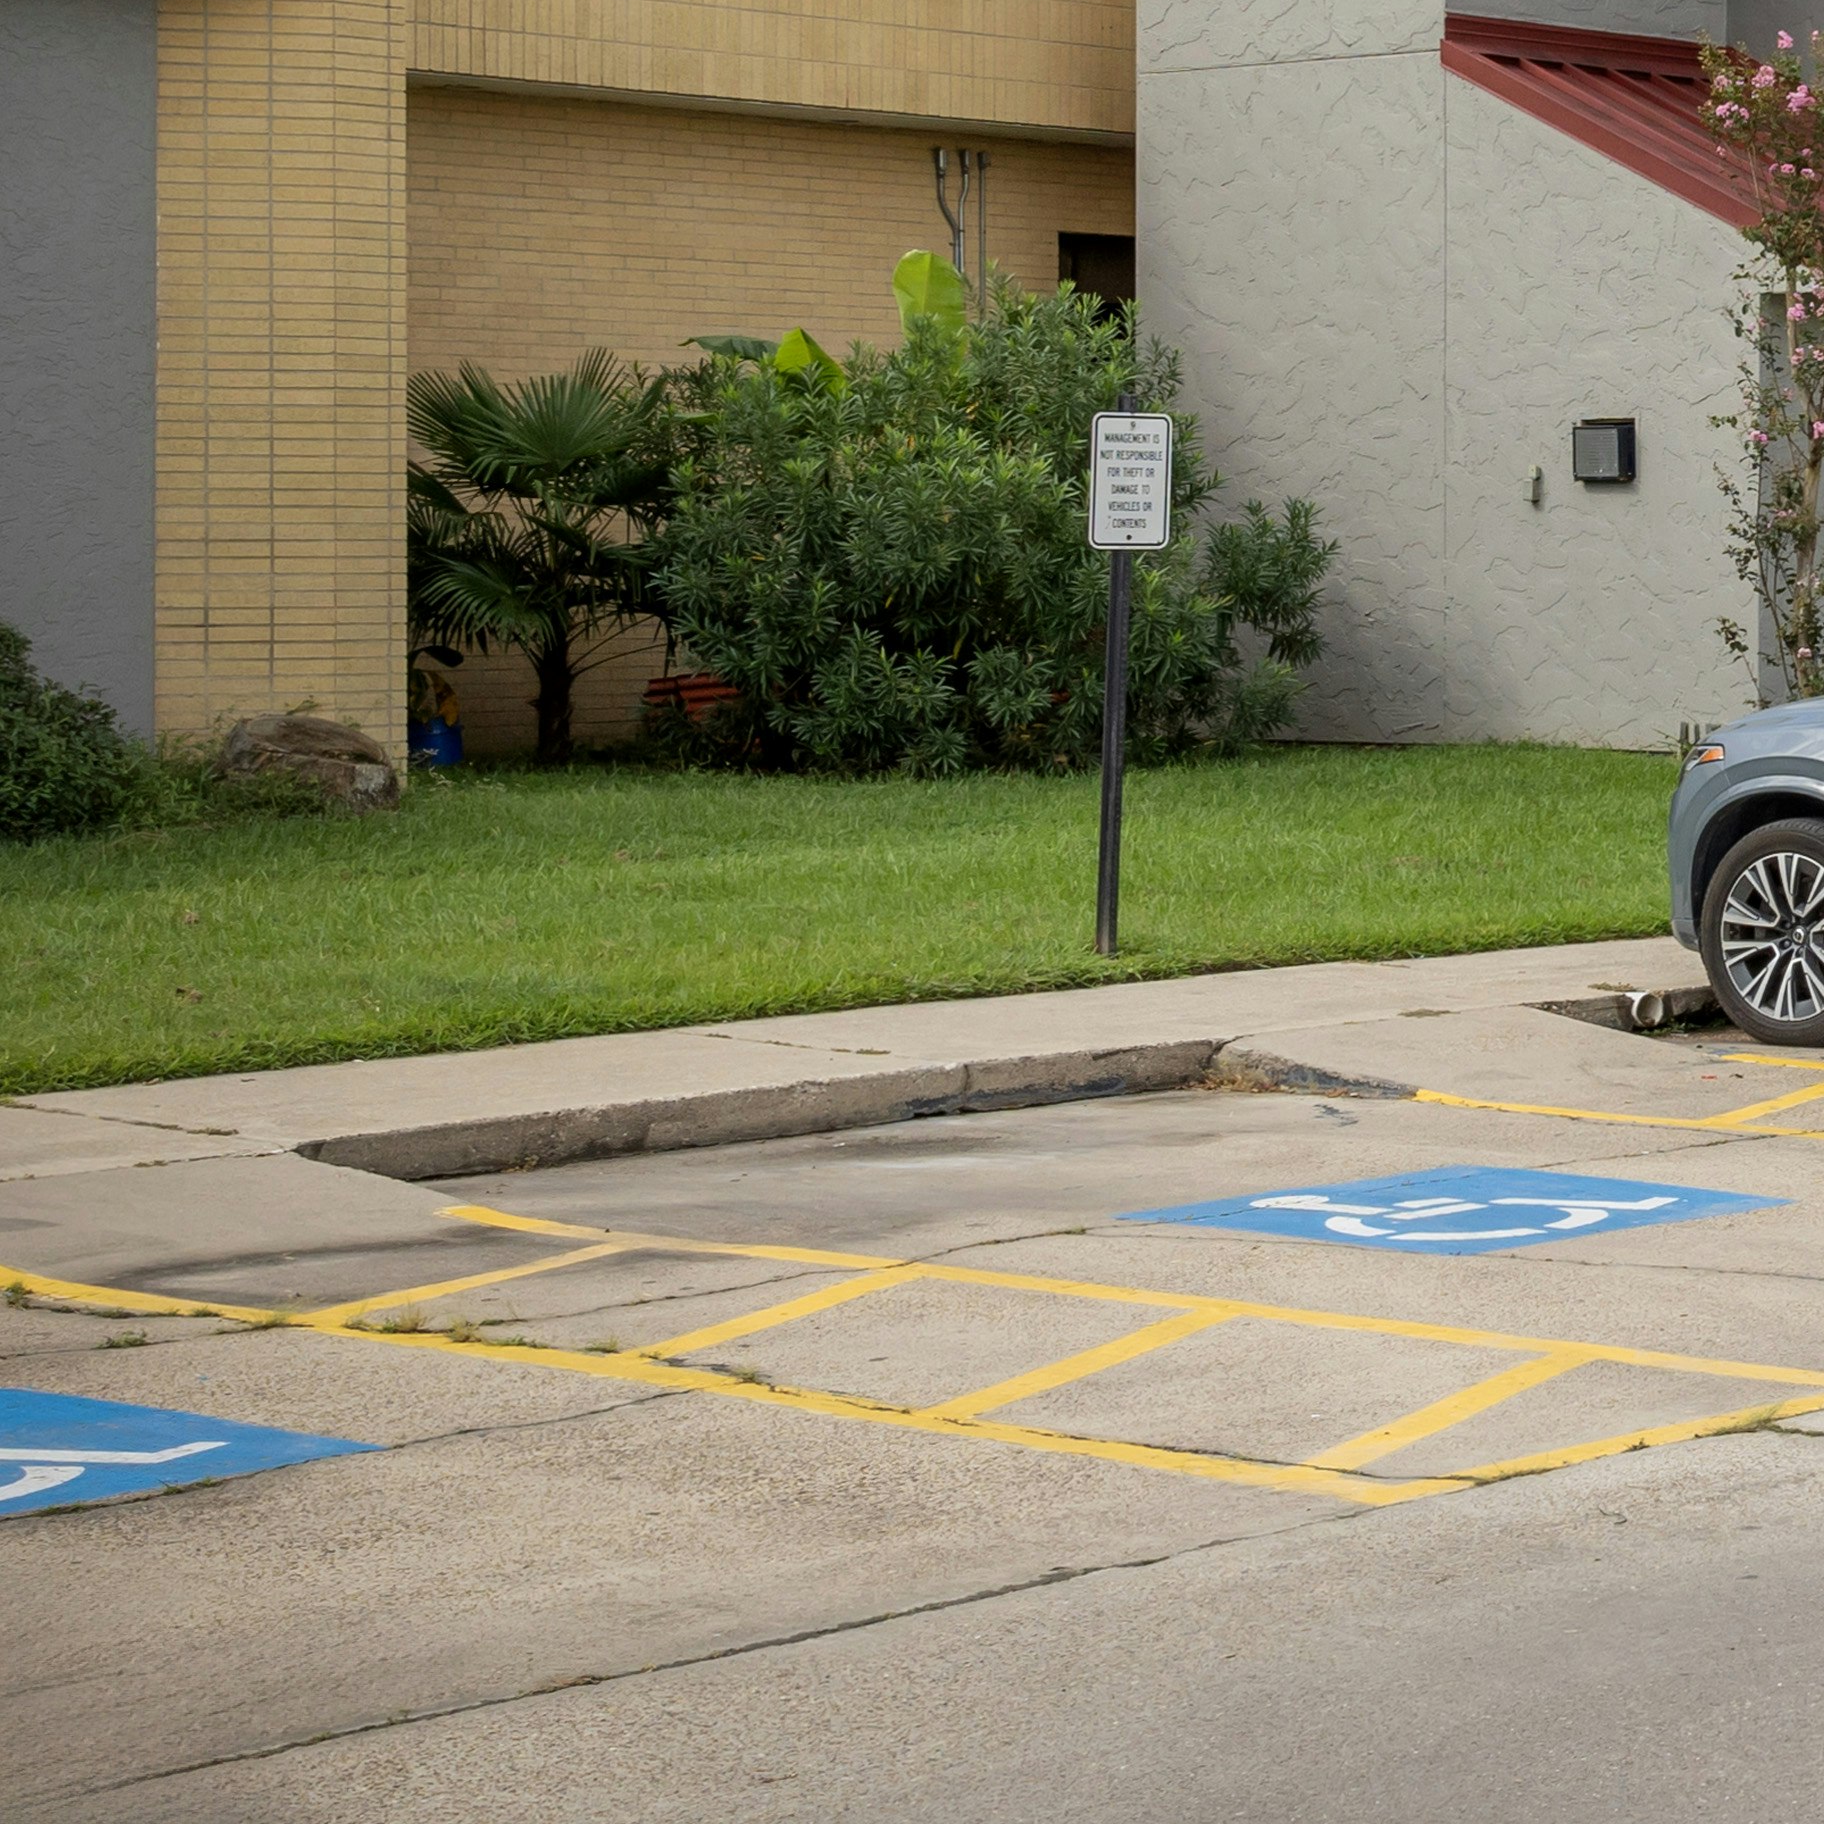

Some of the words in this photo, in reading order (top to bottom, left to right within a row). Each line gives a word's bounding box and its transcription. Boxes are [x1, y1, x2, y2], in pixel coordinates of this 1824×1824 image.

[1104, 432, 1151, 443] MANAGEMENT
[1152, 433, 1160, 444] IS
[1100, 449, 1114, 460] NOT
[1116, 450, 1163, 461] RESPONSIBLE
[1107, 467, 1120, 477] FOR
[1123, 467, 1143, 477] THEFT
[1145, 467, 1155, 478] OR
[1111, 484, 1138, 494] DAMAGE
[1142, 484, 1150, 495] TO
[1108, 501, 1140, 511] VEHICLES
[1143, 501, 1153, 512] OR
[1112, 518, 1147, 528] CONTENTS
